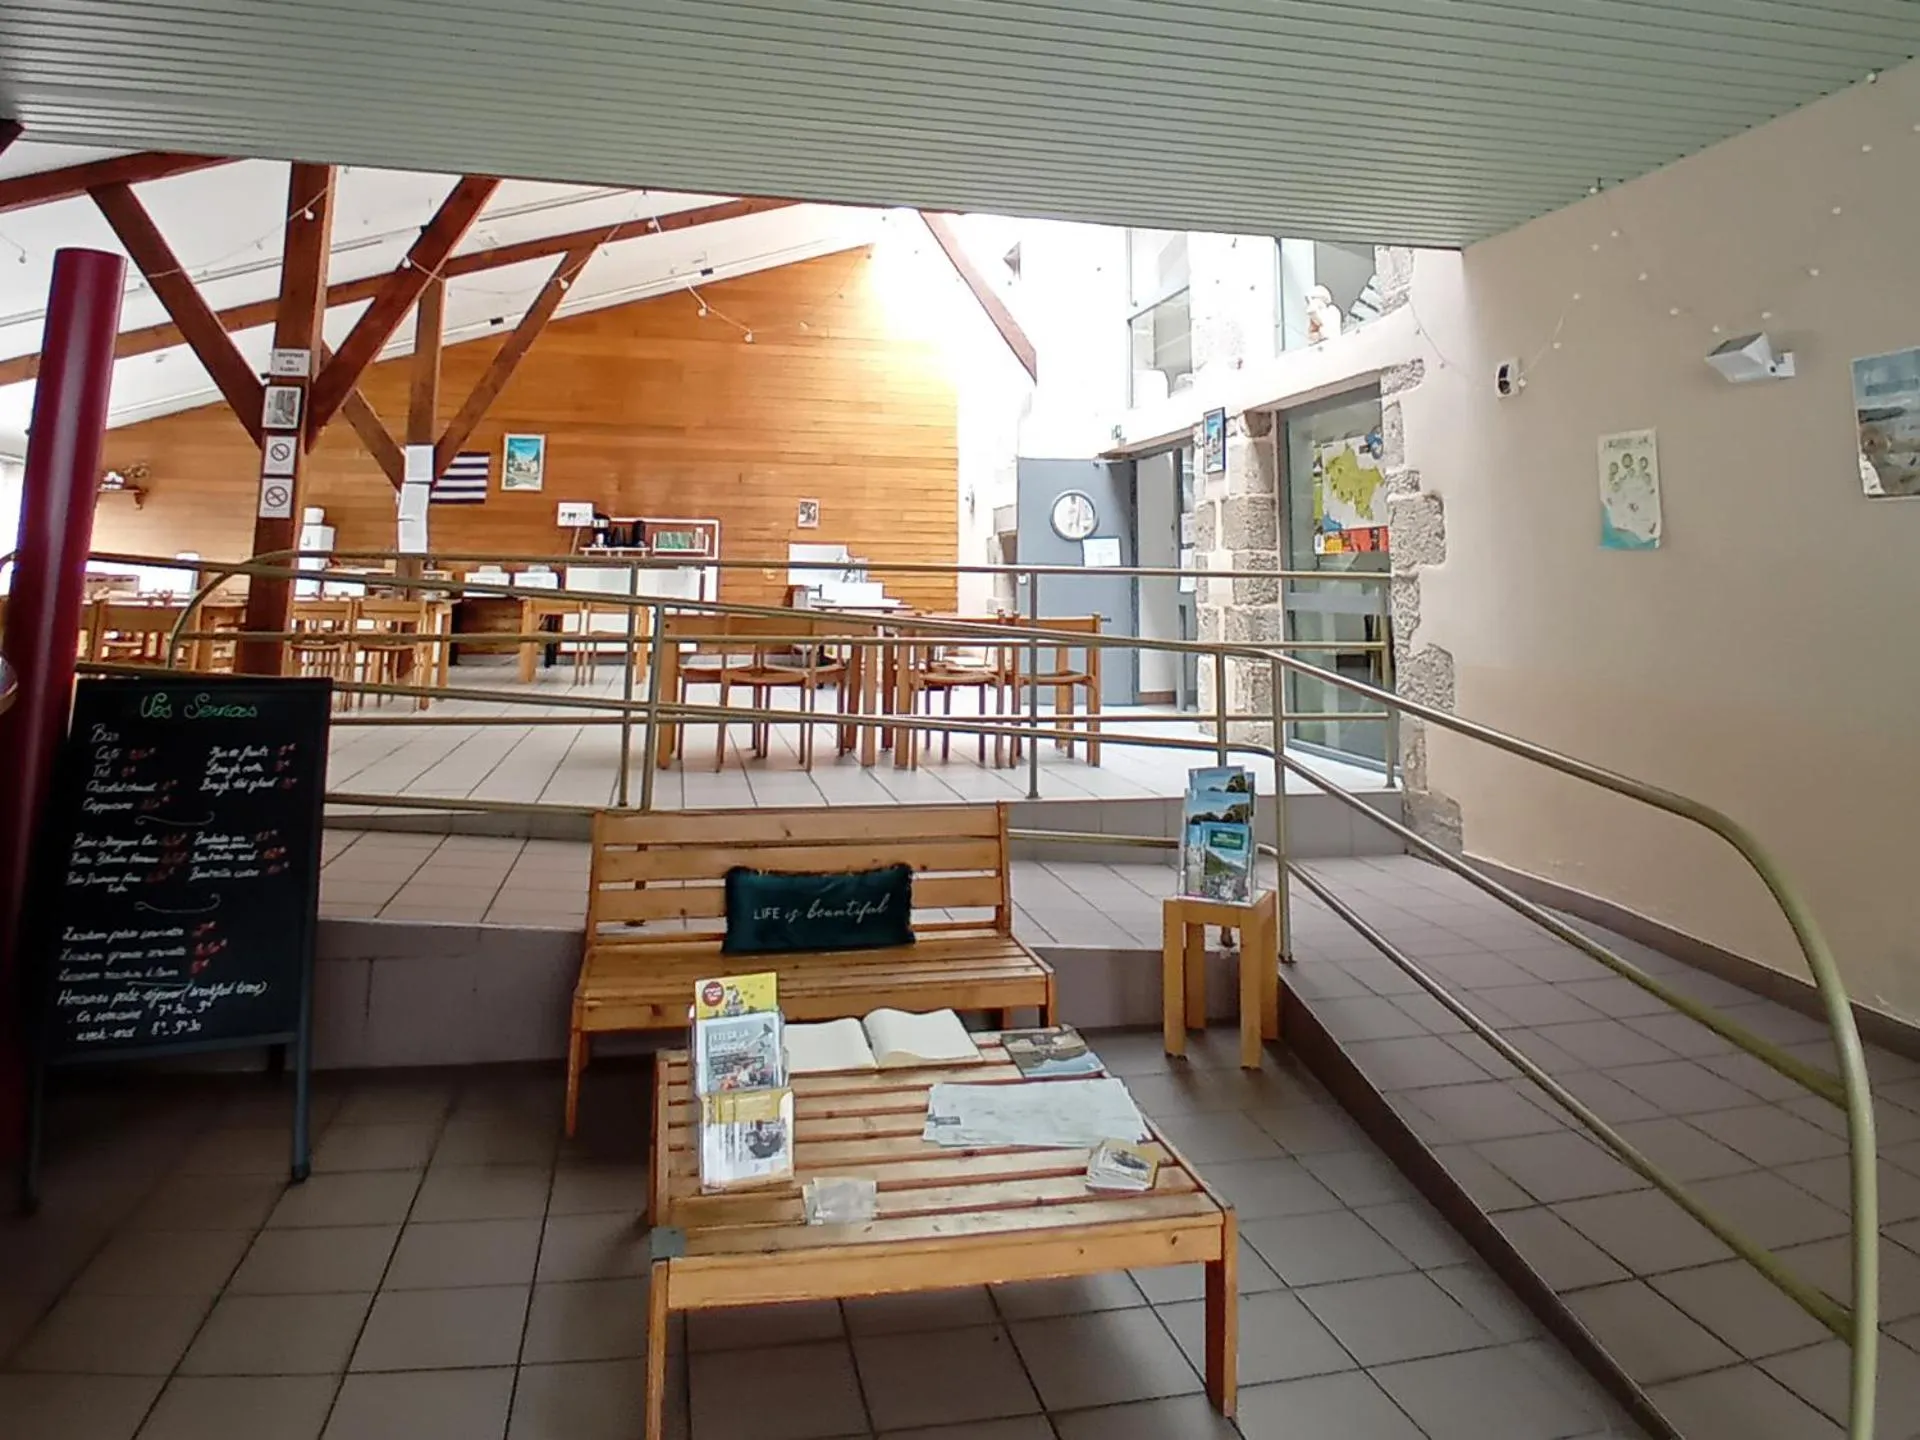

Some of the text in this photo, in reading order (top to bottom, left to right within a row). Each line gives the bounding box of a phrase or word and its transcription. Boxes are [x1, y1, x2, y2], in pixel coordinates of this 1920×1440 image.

[183, 692, 259, 719] Services
[753, 893, 892, 924] LIFE is beautiful
